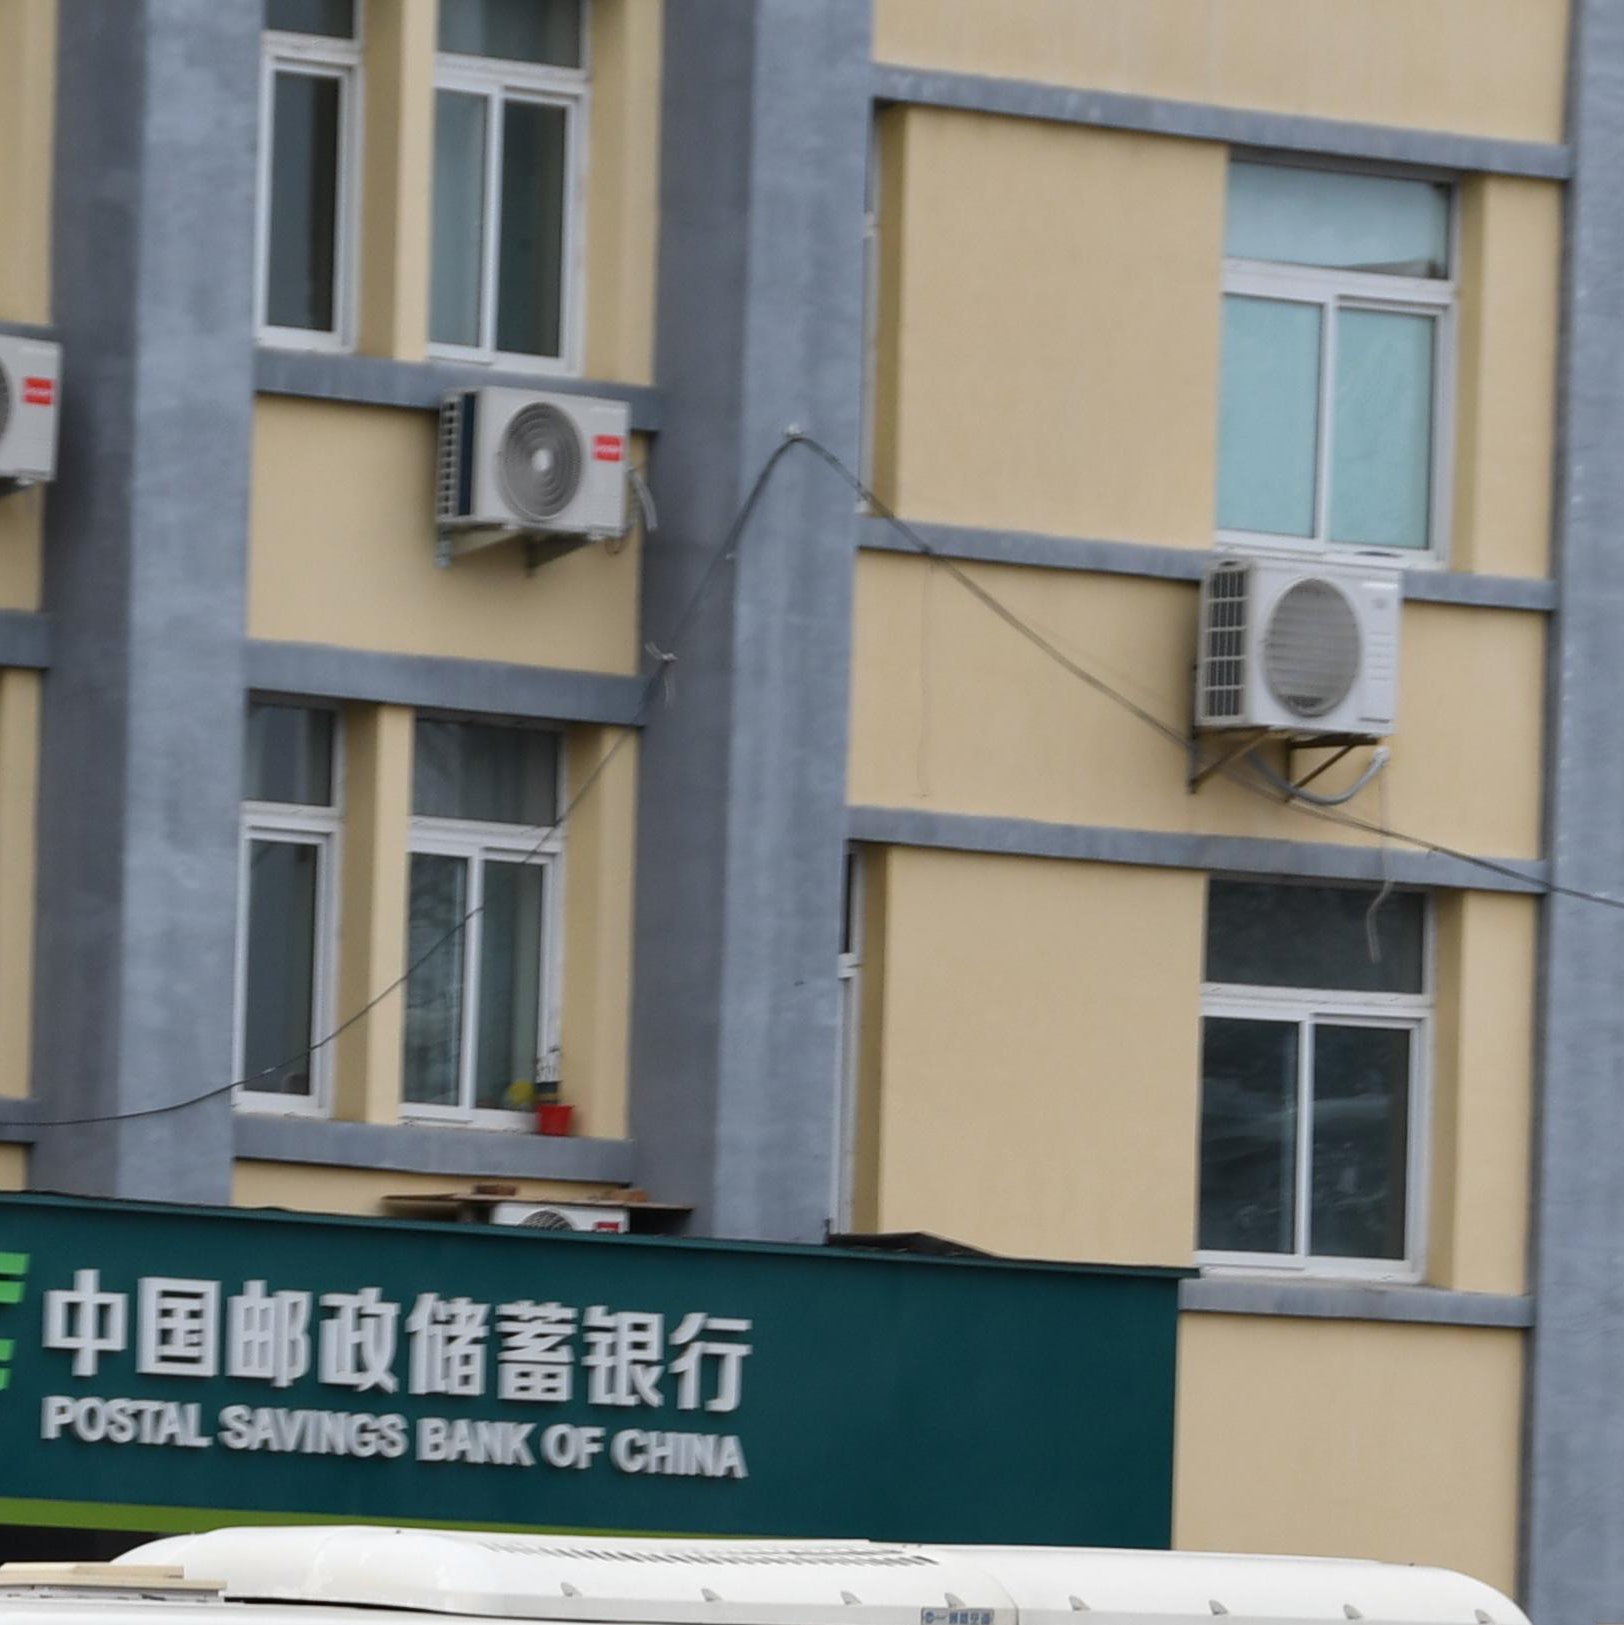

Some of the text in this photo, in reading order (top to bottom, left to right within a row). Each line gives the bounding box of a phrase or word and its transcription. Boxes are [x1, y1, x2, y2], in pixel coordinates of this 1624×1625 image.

[42, 1269, 753, 1413] 中国邮政储蓄银行
[40, 1396, 749, 1479] POSTAL SAVINGS BANK OF CHINA
